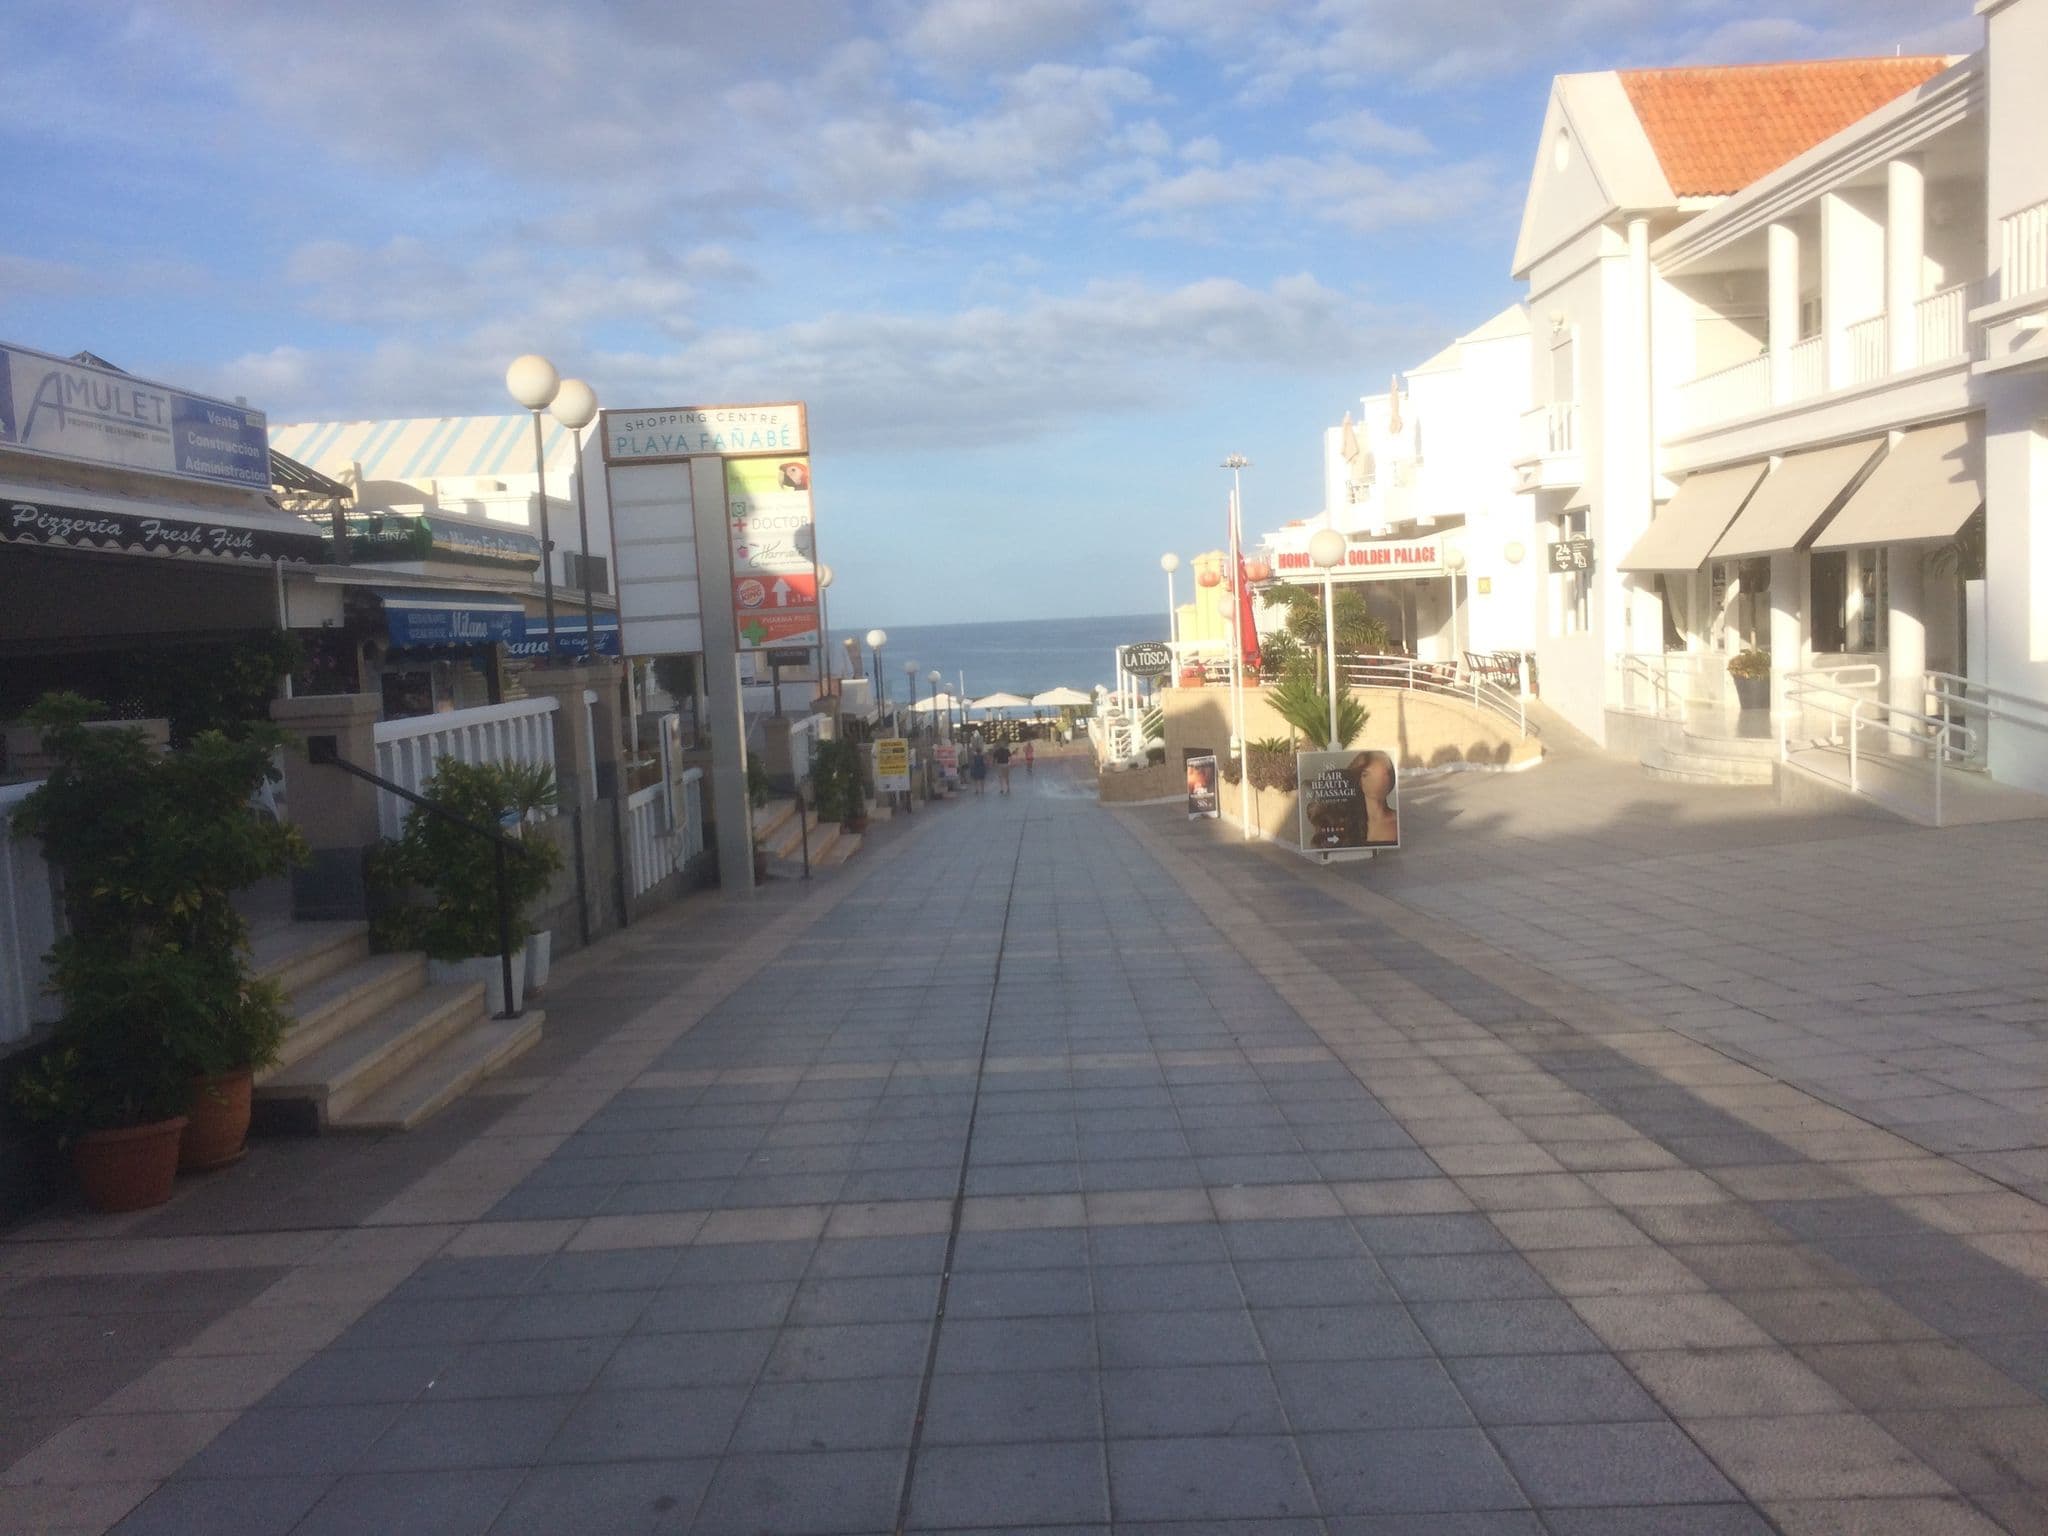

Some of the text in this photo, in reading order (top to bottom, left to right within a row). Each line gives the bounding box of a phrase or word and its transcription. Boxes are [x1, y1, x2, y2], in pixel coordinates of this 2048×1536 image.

[20, 371, 167, 444] AMULET
[206, 410, 240, 430] Venta
[625, 412, 778, 432] SHOPPING CENTRE
[616, 424, 791, 454] PLAYA FAÑABÉ
[752, 515, 808, 530] DOCTOR
[139, 519, 202, 544] Fresh
[208, 528, 257, 549] Fish
[1278, 552, 1310, 569] HONG
[1348, 547, 1391, 566] GOLDEN
[1394, 546, 1435, 564] PALACE
[1555, 543, 1571, 555] 24
[1125, 650, 1170, 667] LA TOSCA
[1311, 780, 1350, 790] BEAUTY
[1318, 771, 1342, 781] HAIR
[1315, 788, 1356, 798] MASSAGE
